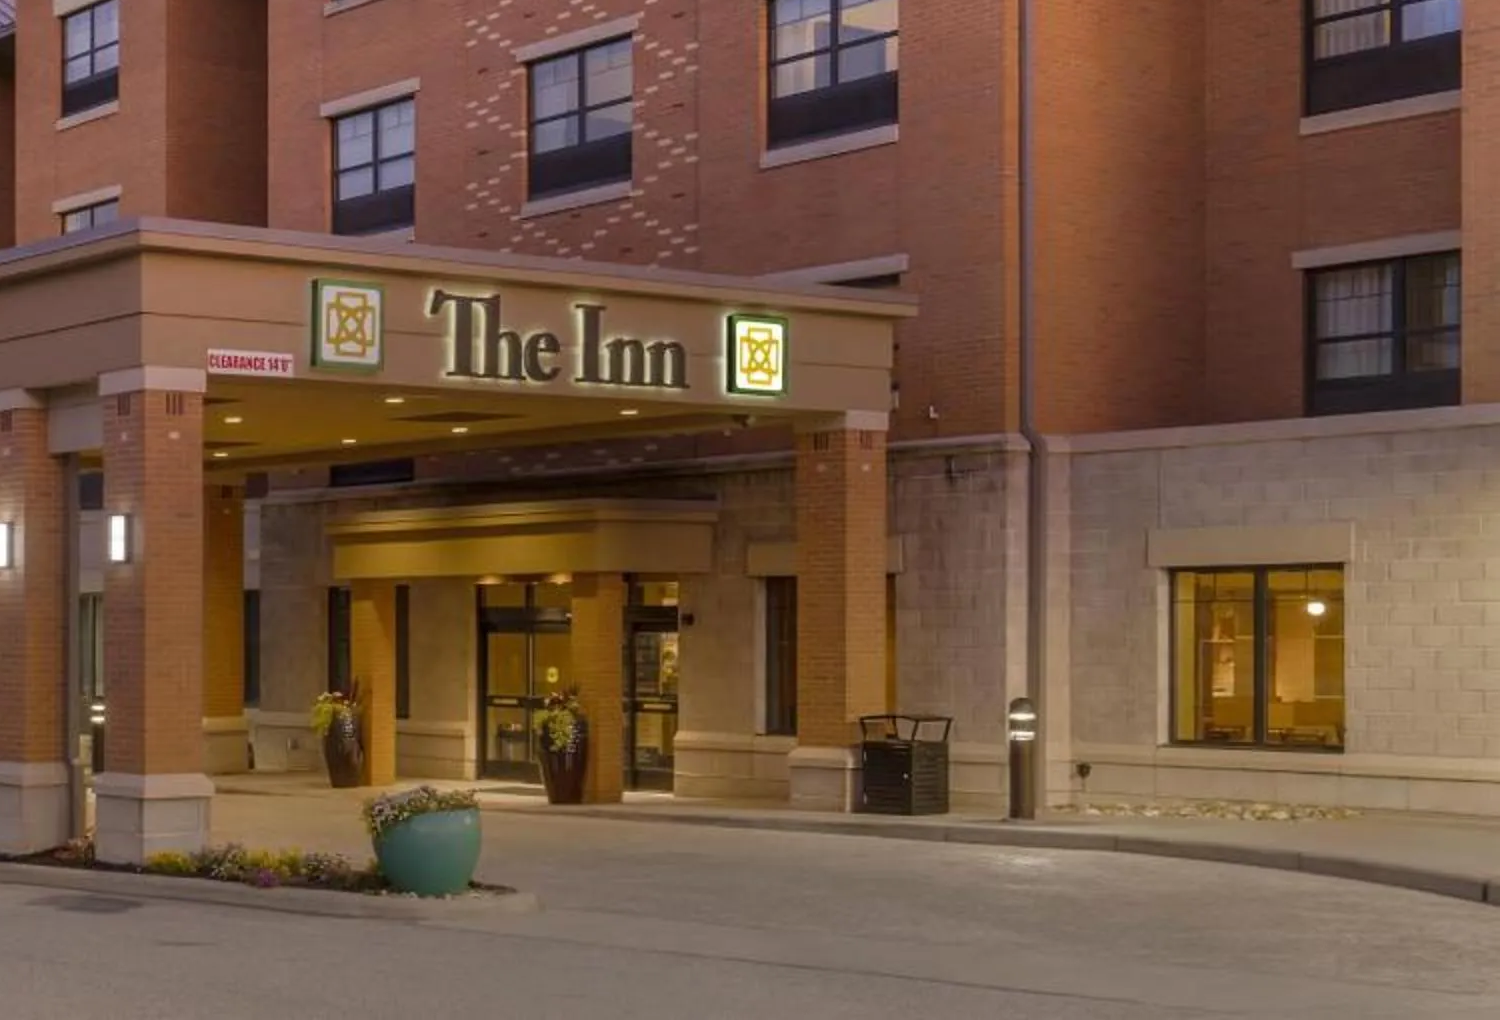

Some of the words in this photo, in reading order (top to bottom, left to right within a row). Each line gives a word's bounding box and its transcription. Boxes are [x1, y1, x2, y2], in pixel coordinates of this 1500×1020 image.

[209, 353, 265, 371] CLEARANCE
[430, 289, 561, 382] The
[575, 303, 690, 390] Inn
